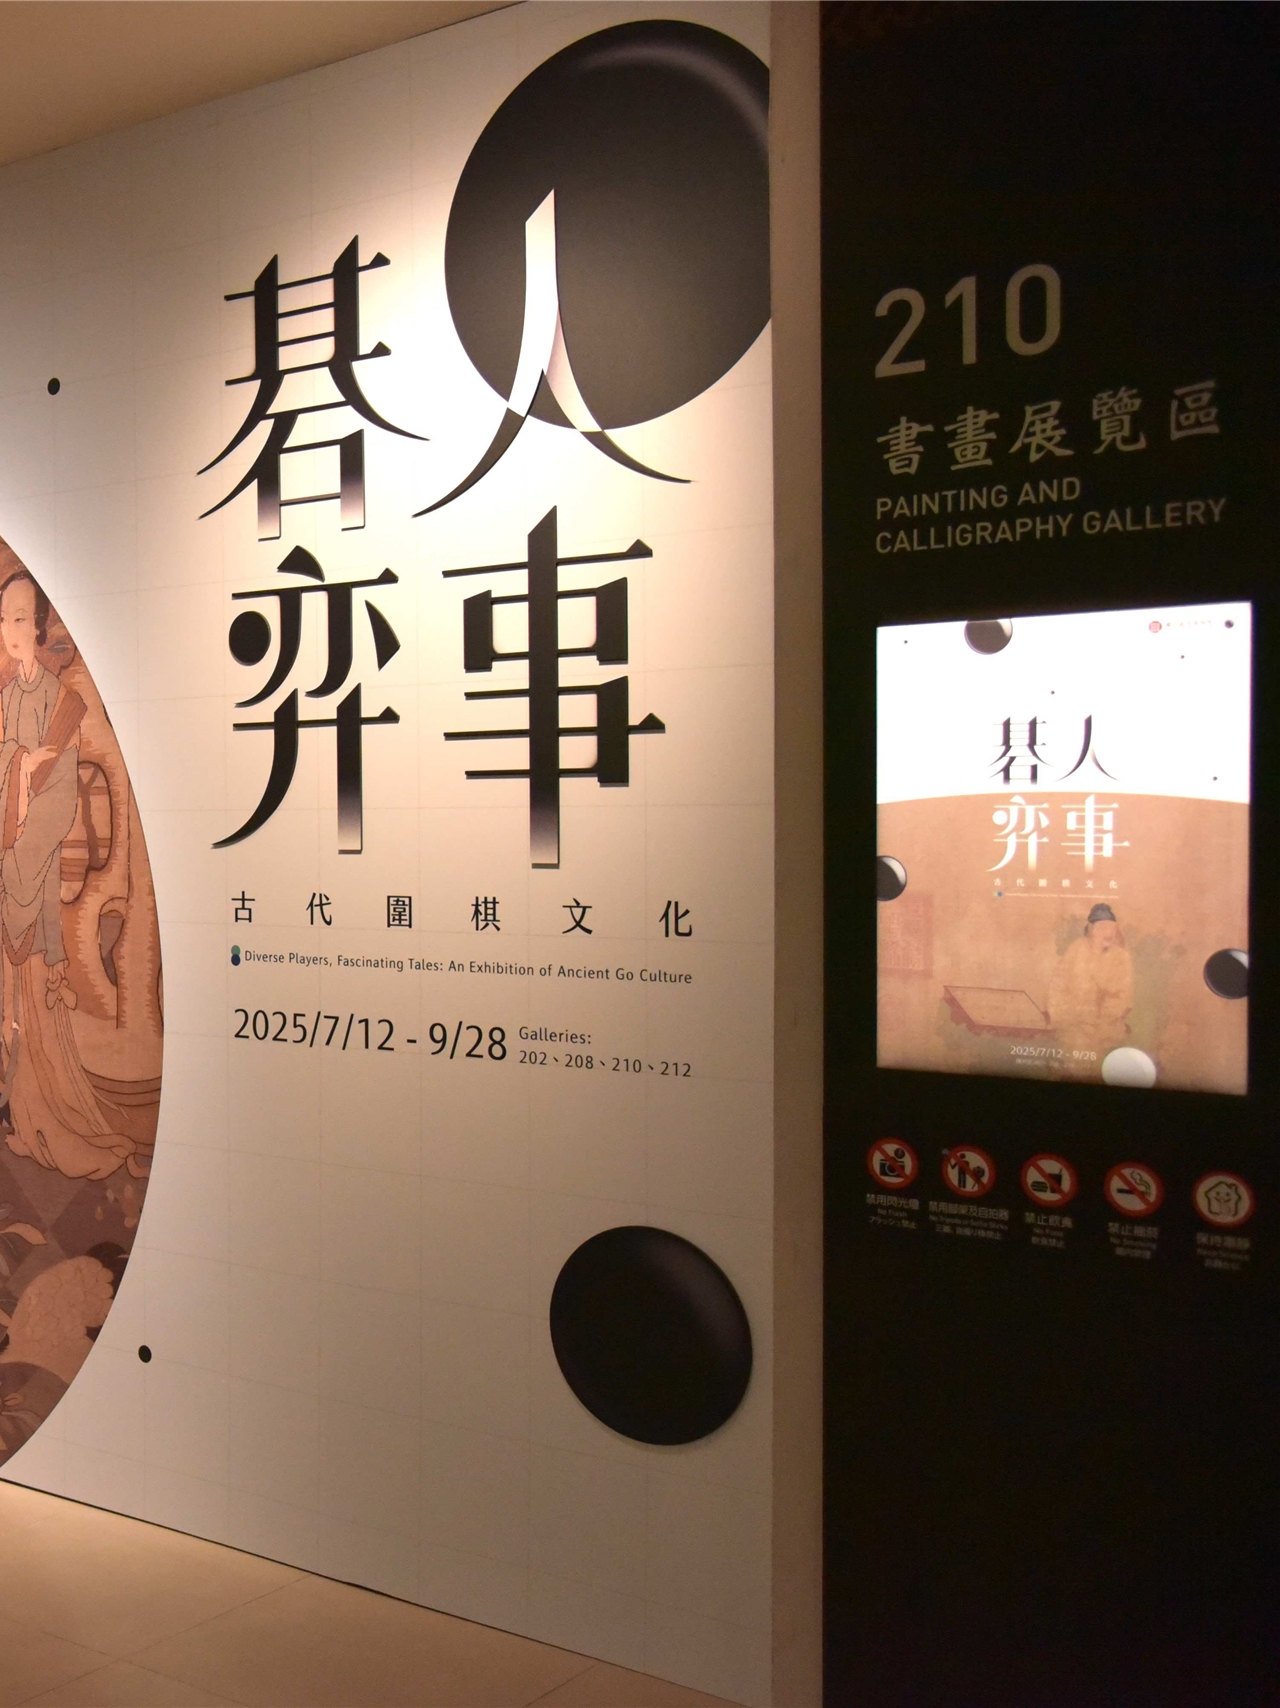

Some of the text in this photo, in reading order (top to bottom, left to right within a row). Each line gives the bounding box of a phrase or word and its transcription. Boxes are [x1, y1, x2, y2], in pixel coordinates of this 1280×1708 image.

[874, 264, 1061, 378] 210
[876, 379, 1220, 476] 書畫展覽區
[876, 477, 1081, 520] PAINTING AND
[875, 498, 1226, 554] CALLIGRAPHY GALLERY
[231, 891, 693, 938] 古代圍棋文化
[244, 950, 692, 984] Diverse Players, Fascinating Tales: An Exhibition of Ancient Go Culture
[233, 1008, 395, 1052] 2025/7/12
[428, 1020, 507, 1061] 9/28
[519, 1026, 592, 1045] Galleries:
[1010, 1045, 1063, 1058] 2025/7/12
[1072, 1050, 1097, 1061] 9/28
